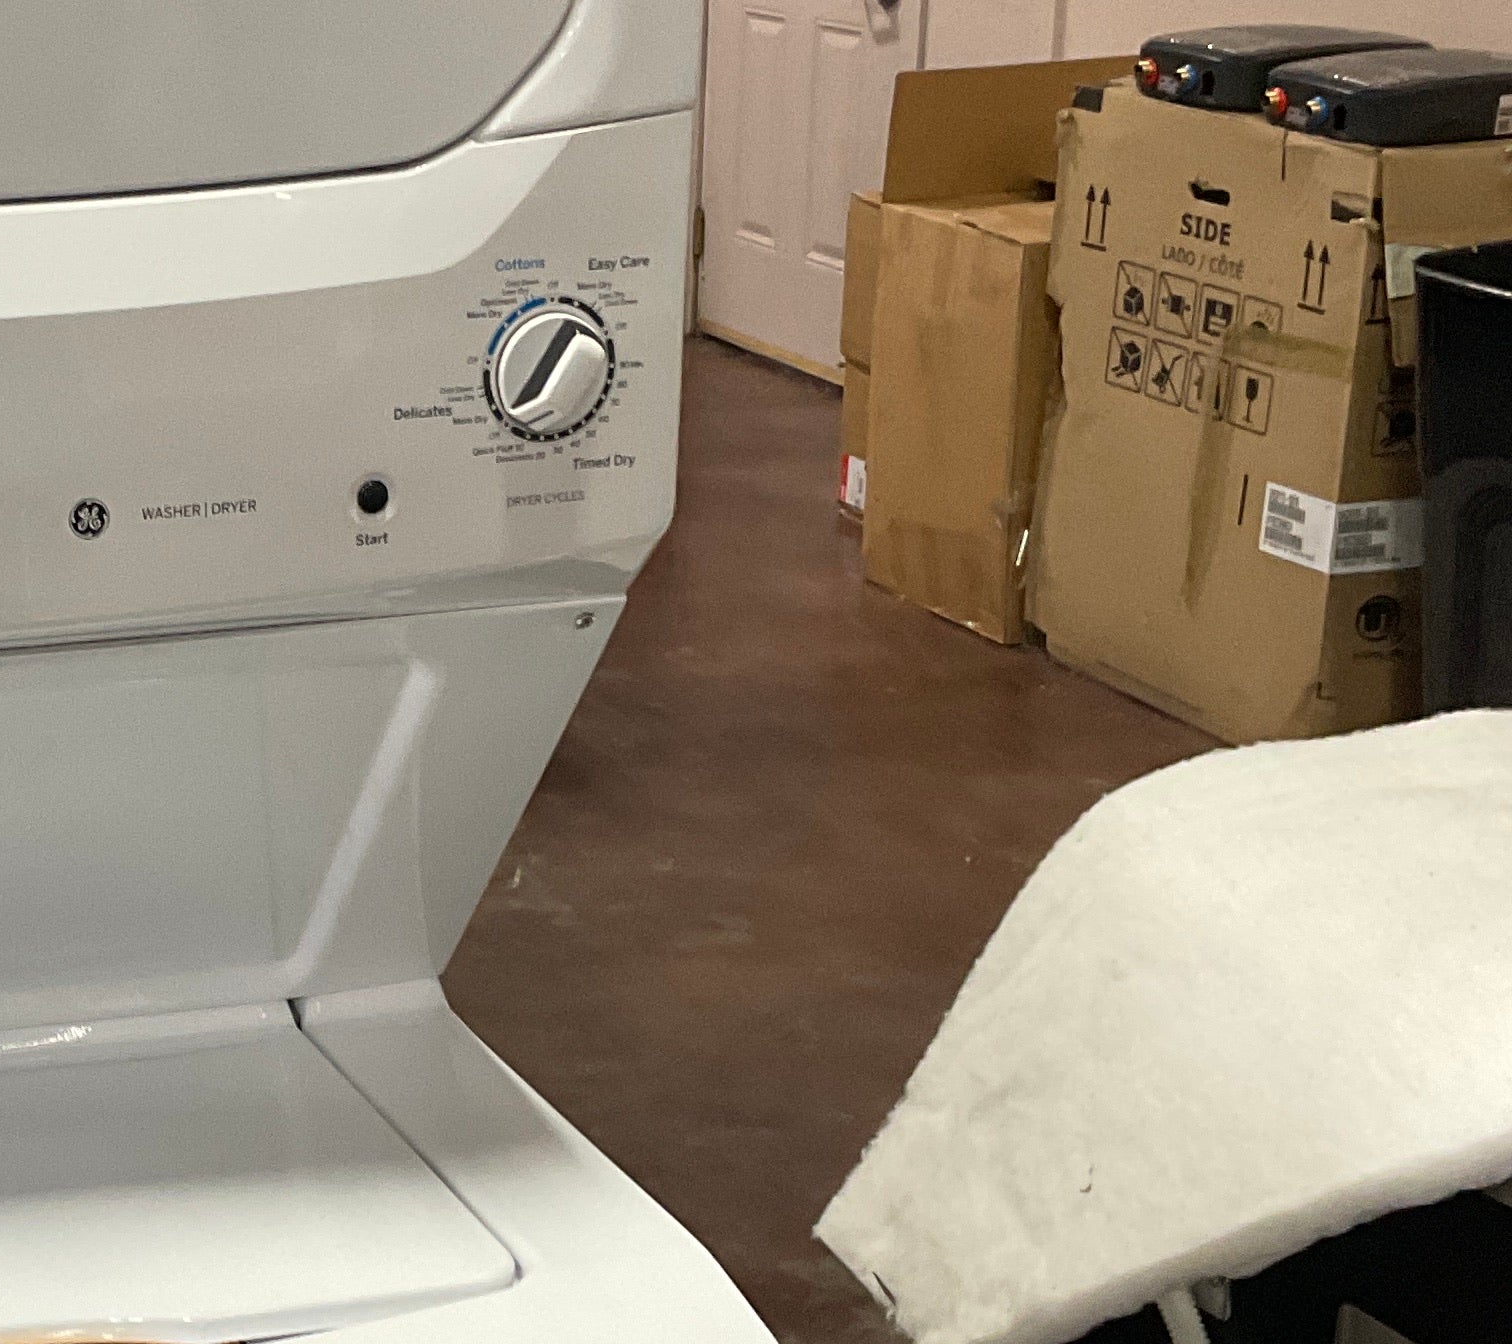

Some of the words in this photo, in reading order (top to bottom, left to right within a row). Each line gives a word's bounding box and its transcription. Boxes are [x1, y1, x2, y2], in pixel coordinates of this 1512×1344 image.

[1180, 212, 1232, 246] SIDE
[495, 258, 545, 272] Cottons
[588, 257, 618, 272] Easy
[620, 256, 650, 269] Care
[394, 405, 453, 420] Delicates
[573, 456, 610, 470] Timed
[614, 454, 636, 469] Dry
[506, 494, 542, 508] DRYER
[544, 489, 585, 504] CYCLES
[141, 503, 201, 520] WASHER
[211, 499, 257, 515] DRYER
[356, 532, 389, 546] Start
